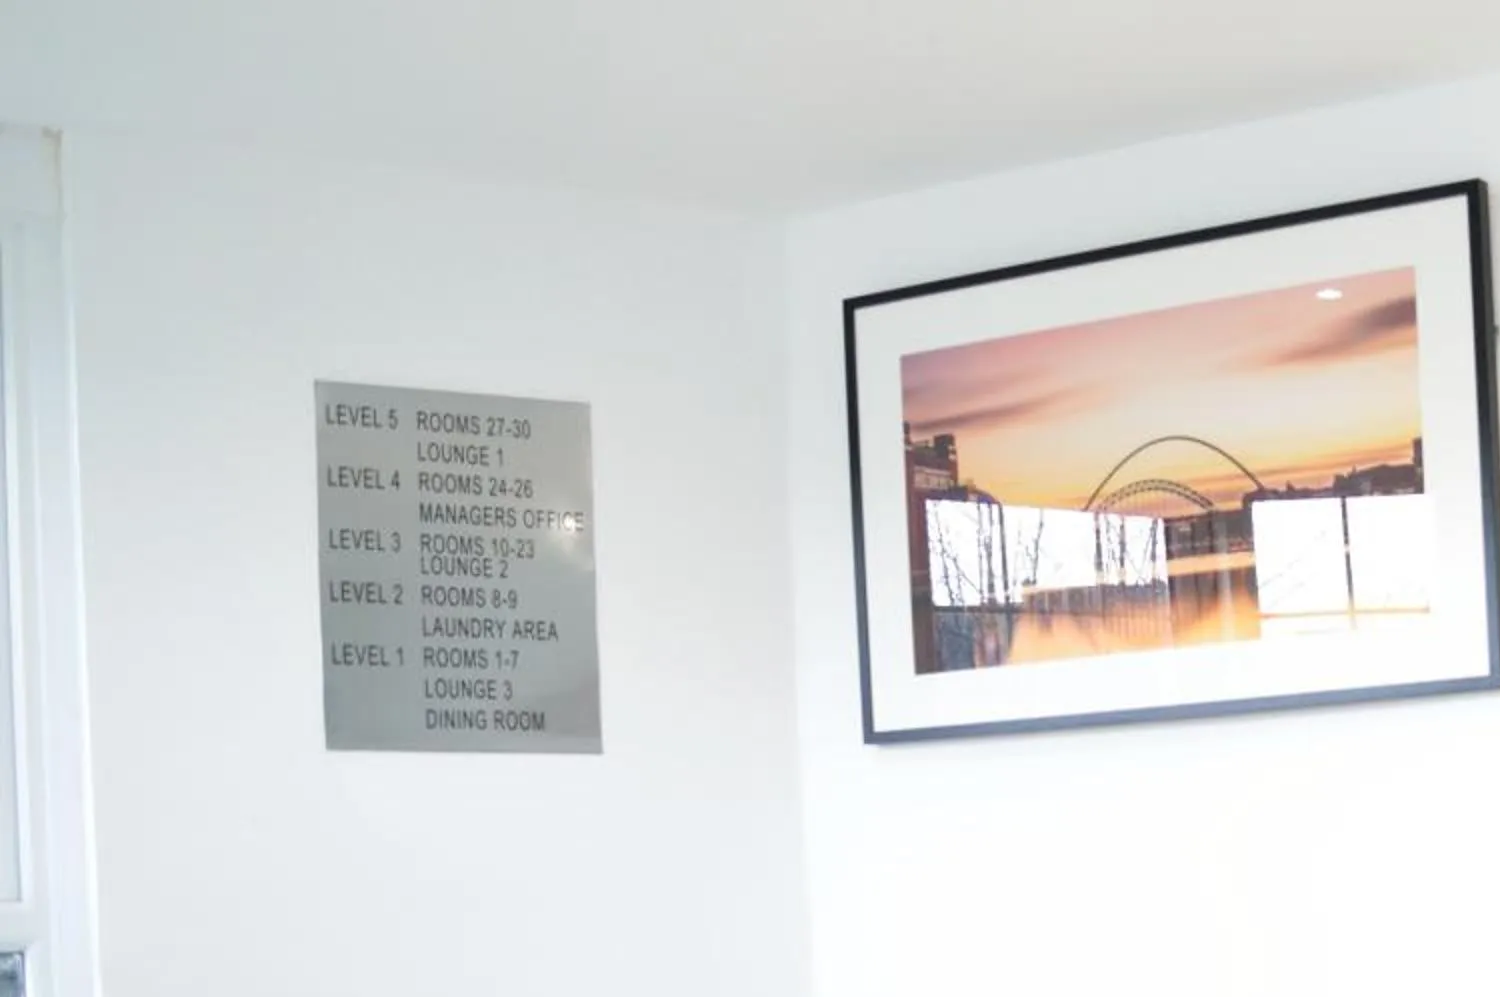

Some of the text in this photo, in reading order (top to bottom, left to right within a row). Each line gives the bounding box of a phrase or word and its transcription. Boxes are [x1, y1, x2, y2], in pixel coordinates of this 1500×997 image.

[325, 404, 531, 439] LEVEL 5 ROOMS 27-30
[417, 442, 504, 466] LOUNGE 1
[327, 467, 534, 498] LEVEL 4 ROOMS 24-26
[420, 504, 585, 532] MANAGERS OFFICE
[329, 529, 534, 559] LEVEL 3 ROOMS 10-23
[421, 556, 508, 579] LOUNGE 2
[330, 581, 518, 610] LEVEL 2 ROOMS 8-9
[422, 617, 558, 641] LAUNDRY AREA
[332, 645, 520, 669] LEVEL 1 ROOMS 1-7
[425, 679, 513, 700] LOUNGE 3
[426, 710, 545, 731] DINING ROOM
